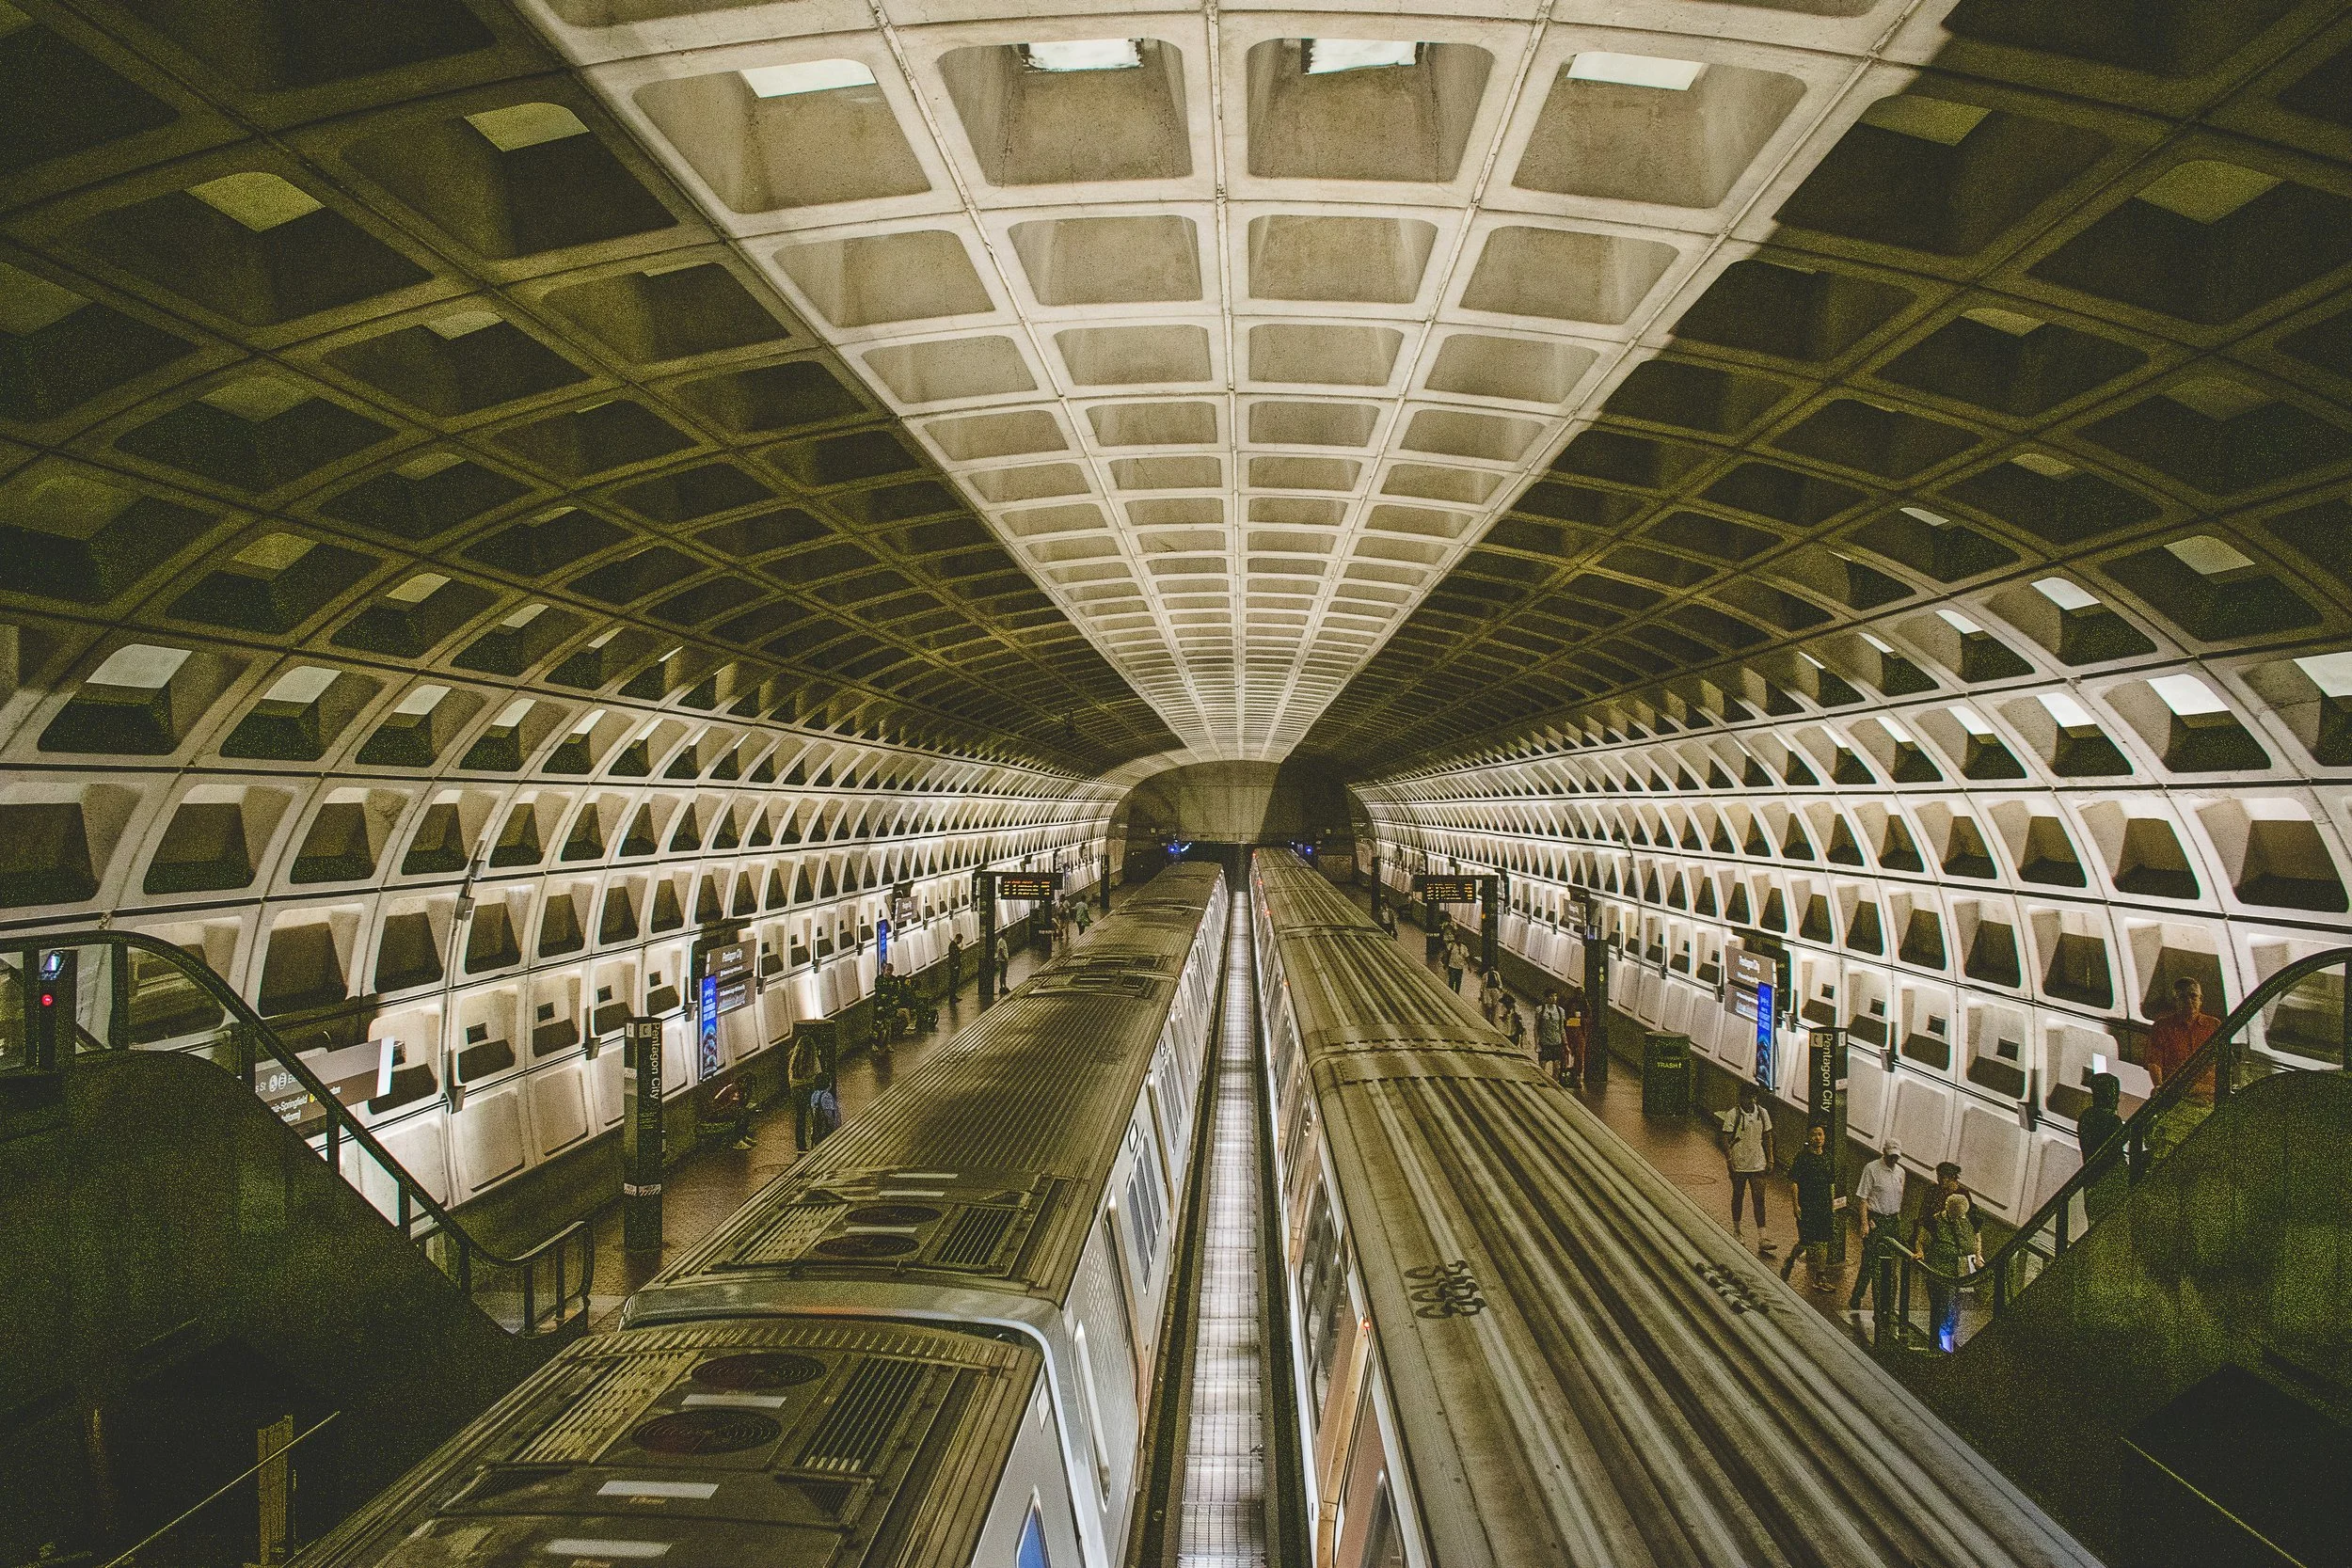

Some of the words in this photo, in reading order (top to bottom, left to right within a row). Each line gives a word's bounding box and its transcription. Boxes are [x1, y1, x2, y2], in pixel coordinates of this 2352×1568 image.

[649, 1022, 660, 1074] Pentagon
[1820, 1033, 1833, 1086] Pentagon
[649, 1078, 660, 1100] City
[1820, 1089, 1833, 1112] City
